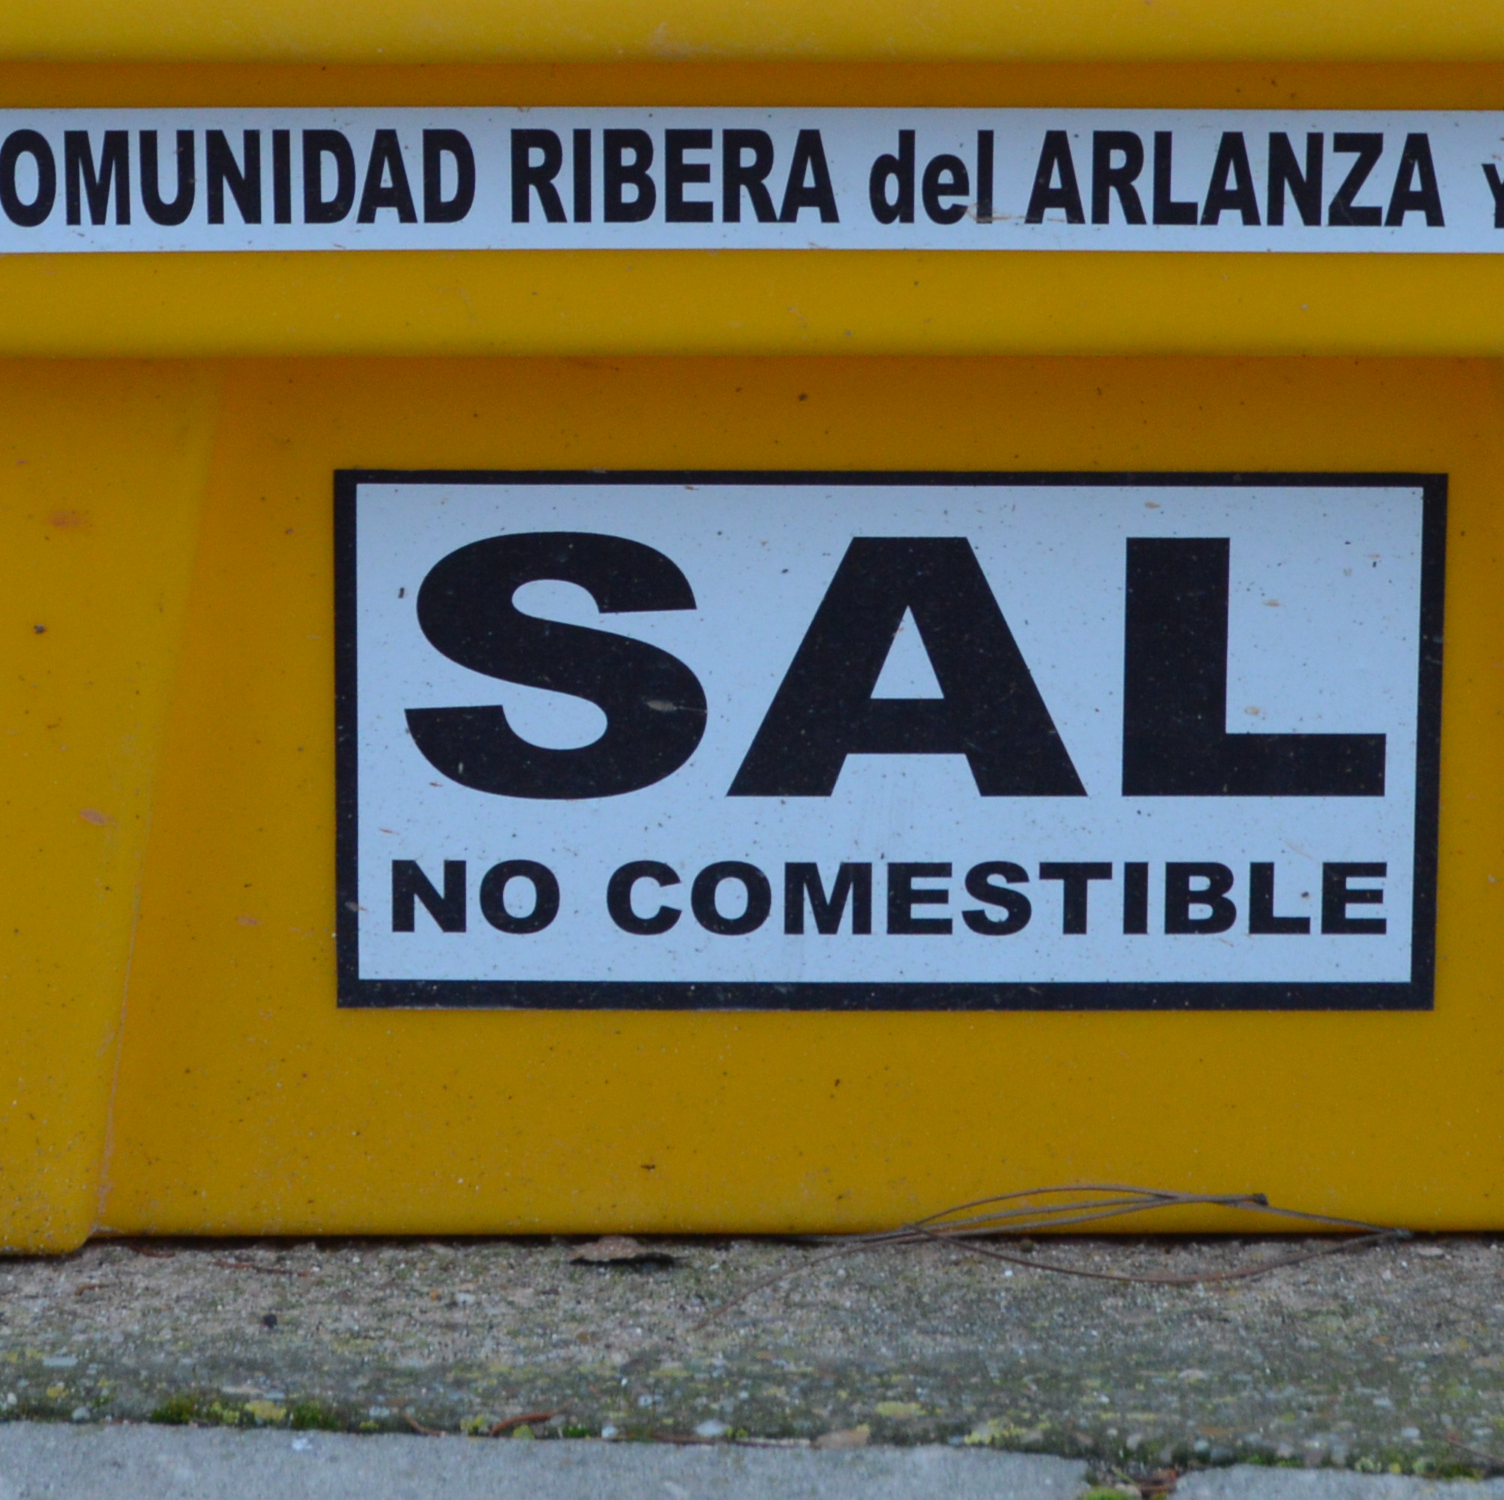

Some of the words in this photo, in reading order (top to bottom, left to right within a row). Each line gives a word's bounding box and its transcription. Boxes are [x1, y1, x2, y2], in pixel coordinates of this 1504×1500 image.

[510, 128, 841, 224] RIBERA
[869, 129, 995, 225] del
[1024, 129, 1446, 228] ARLANZA
[404, 531, 1388, 801] SAL
[391, 859, 560, 935] NO
[606, 860, 1388, 936] COMESTIBLE
